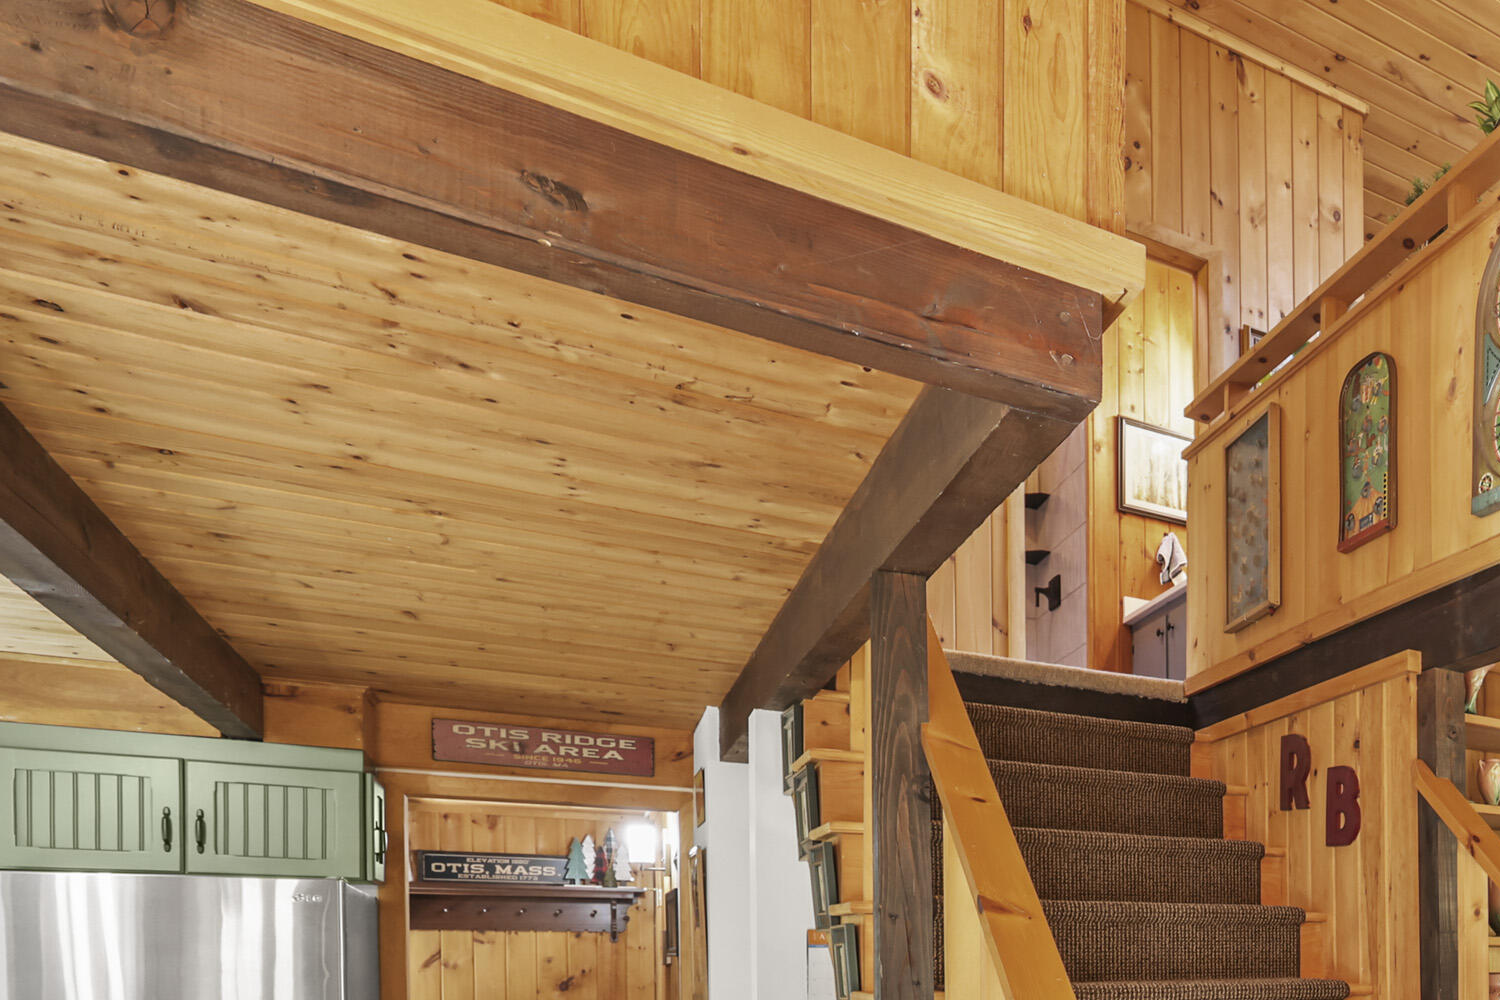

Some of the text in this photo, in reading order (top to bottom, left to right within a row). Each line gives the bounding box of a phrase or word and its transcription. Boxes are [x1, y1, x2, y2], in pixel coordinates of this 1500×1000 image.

[452, 724, 637, 750] OTIS RIDGE
[465, 737, 624, 760] SKI AREA
[1279, 733, 1312, 811] R
[1325, 765, 1362, 847] B
[431, 862, 562, 877] OTIS, MASS.
